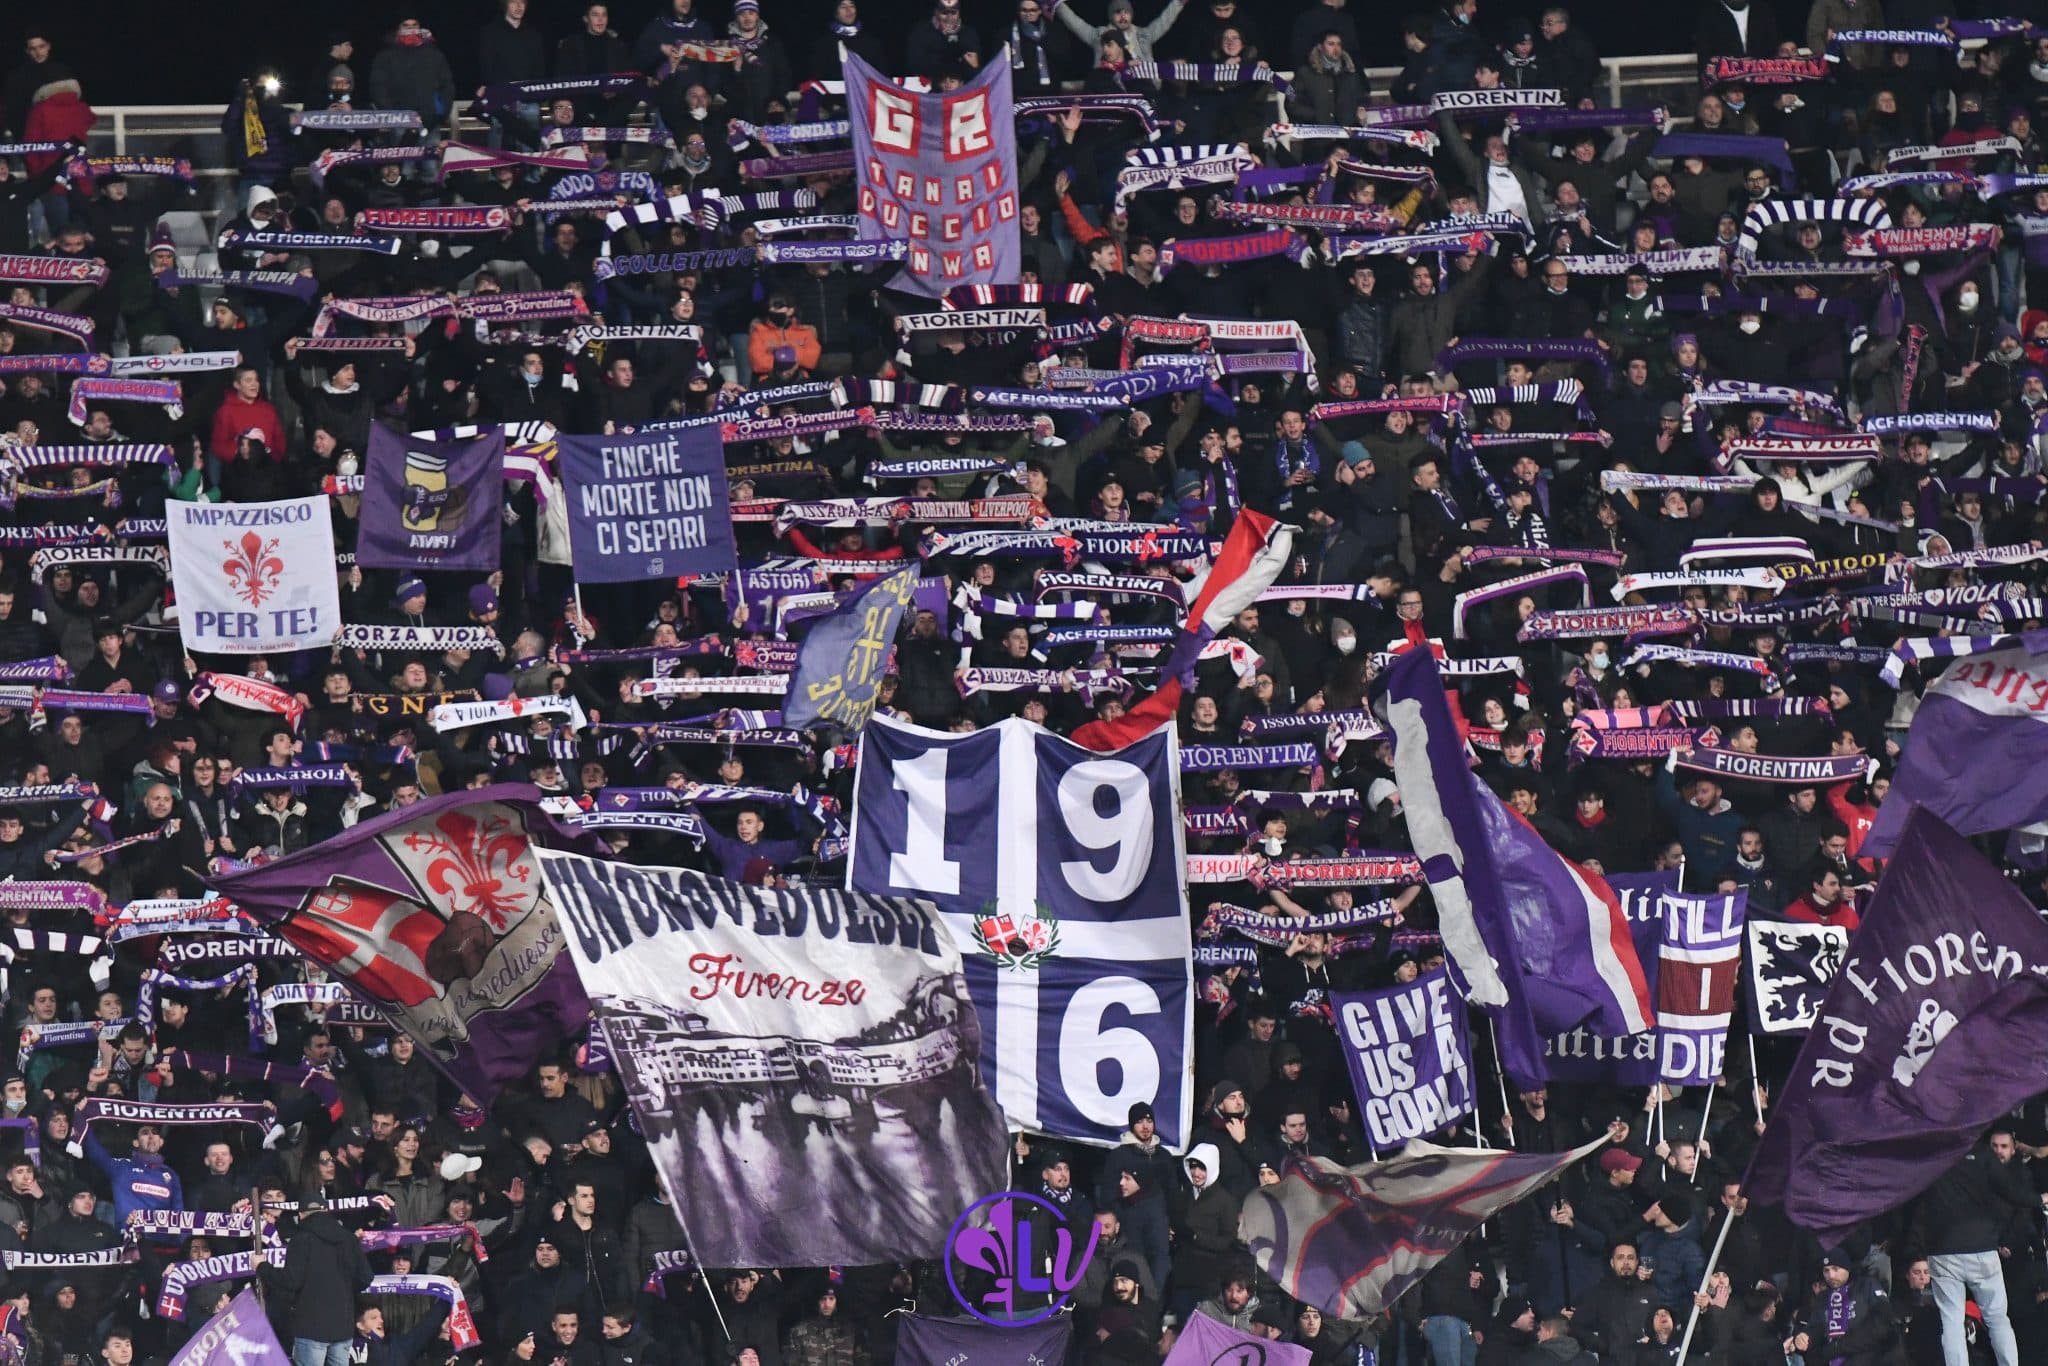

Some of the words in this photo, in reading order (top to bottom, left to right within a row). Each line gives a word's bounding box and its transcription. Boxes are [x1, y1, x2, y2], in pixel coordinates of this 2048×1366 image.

[1838, 31, 1862, 41] ACF
[1865, 31, 1949, 43] FIORENTINA
[521, 79, 600, 93] FIORENTINA
[1437, 91, 1557, 107] FIORENTIN
[302, 114, 327, 127] ACF
[330, 112, 410, 125] FIORENTINA
[364, 208, 487, 227] FIORENTINA
[1246, 204, 1355, 222] FIORENTINA
[244, 231, 275, 243] ACF
[278, 232, 373, 246] FIORENTINA
[1878, 225, 1967, 244] FIORENTINA
[459, 300, 500, 320] Forza
[501, 295, 571, 315] Fiorentina
[908, 311, 1041, 328] FIORENTINA
[573, 325, 692, 344] FIORENTINA
[1217, 323, 1292, 337] FIORENTINA
[171, 356, 235, 367] VIOLA
[735, 392, 758, 407] ACF
[986, 392, 1019, 404] ACF
[736, 416, 780, 435] Forza
[780, 408, 855, 430] Fiorentina
[1866, 416, 1894, 433] ACF
[1897, 412, 1994, 430] FIORENTINA
[601, 434, 680, 478] FINCHÈ
[906, 458, 995, 474] FIORENTINA
[581, 482, 659, 517] MORTE
[663, 475, 713, 508] NON
[185, 503, 312, 526] IMPAZZISCO
[911, 501, 970, 519] FIORENTINA
[976, 499, 1030, 518] LIVERPOOL
[597, 522, 620, 556] CI
[626, 514, 707, 554] SEPARI
[1086, 536, 1205, 555] FIORENTINA
[748, 571, 811, 591] ASTORI
[1039, 571, 1165, 592] FIORENTINA
[1498, 561, 1582, 590] FIORENTINA
[1649, 567, 1744, 580] FIORENTINA
[1889, 591, 1924, 607] SEMPRE
[1945, 581, 2001, 604] VIOLA
[194, 610, 259, 639] PER
[269, 605, 318, 638] TE!
[1550, 612, 1664, 631] FIORENTINA
[343, 626, 416, 641] FORZA
[1055, 631, 1085, 643] ACF
[1089, 627, 1173, 640] FIORENTINA
[1261, 713, 1305, 728] ROSSI
[741, 729, 801, 744] VIOLA
[1603, 732, 1693, 751] FIORENTINA
[1715, 753, 1835, 778] FIORENTINA
[567, 812, 695, 831] FIORENTINA
[1284, 861, 1404, 880] FIORENTINA
[1661, 893, 1746, 945] TILL
[167, 937, 303, 962] FIORENTIN
[688, 952, 866, 1006] Firenze
[1341, 977, 1452, 1049] GIVE
[43, 1029, 86, 1043] Fiorentina
[1360, 1042, 1416, 1097] US
[1434, 1023, 1466, 1074] A
[1661, 1032, 1728, 1080] DIE
[99, 1101, 242, 1120] FIORENTINA
[1366, 1064, 1472, 1145] GOAL!
